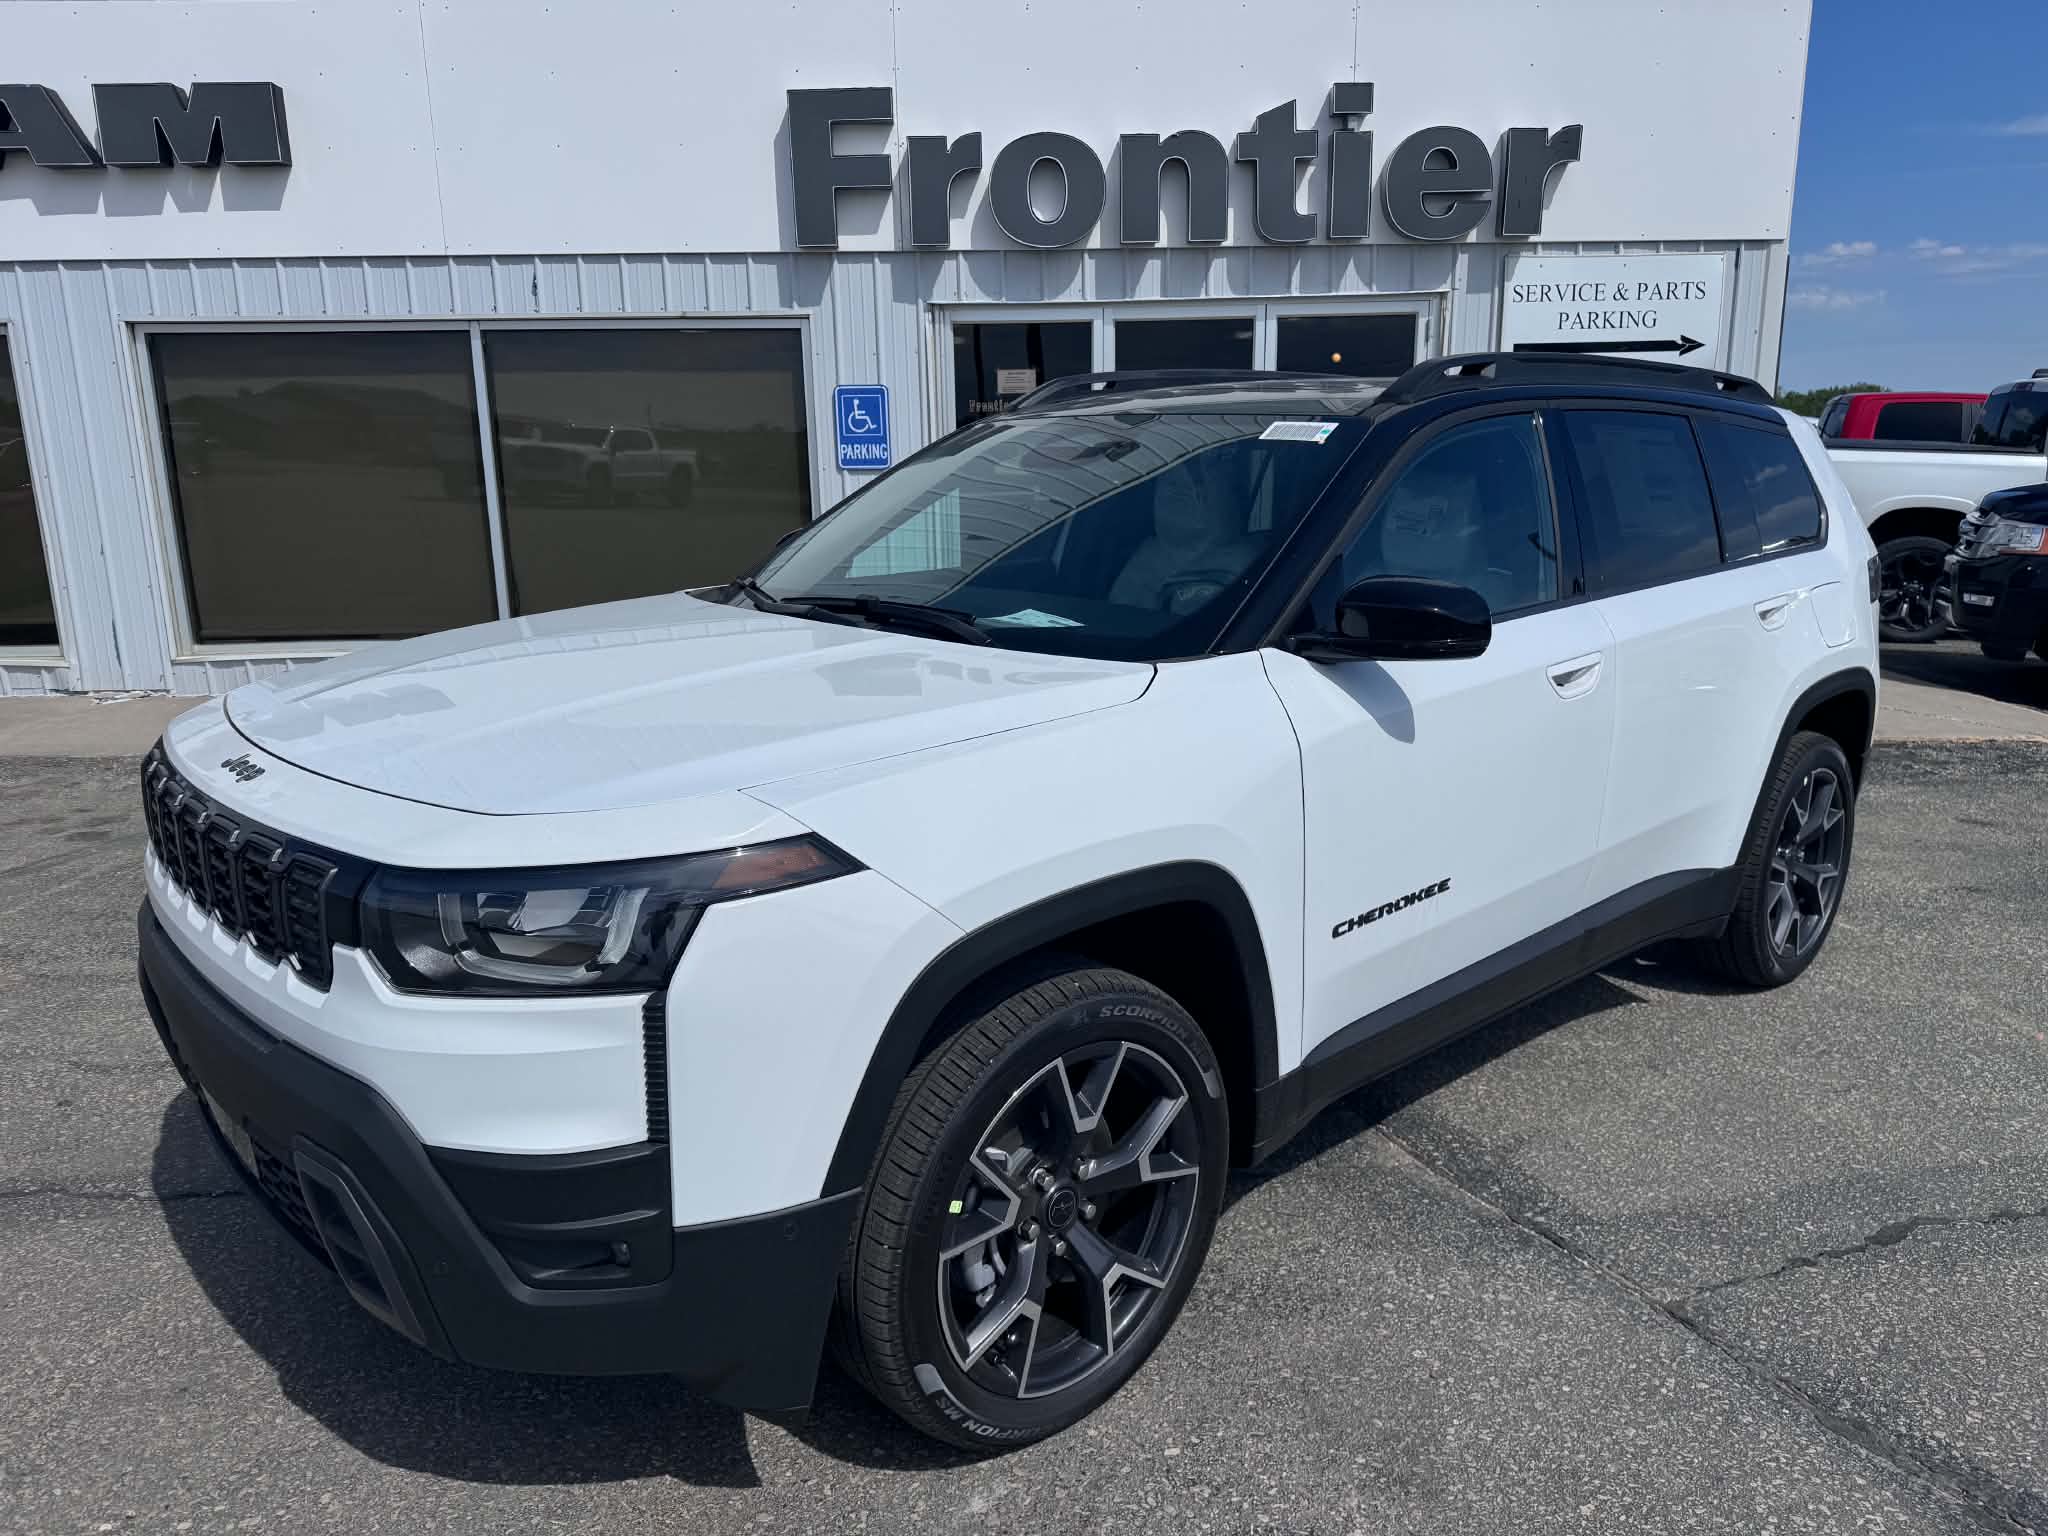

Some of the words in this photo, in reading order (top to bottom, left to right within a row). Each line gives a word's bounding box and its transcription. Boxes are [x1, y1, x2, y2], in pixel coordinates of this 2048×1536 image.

[787, 82, 1583, 248] Frontier
[1512, 283, 1606, 303] SERVICE
[1612, 282, 1629, 301] &
[1637, 281, 1707, 300] PARTS
[1557, 310, 1657, 330] PARKING
[840, 443, 888, 460] PARKING
[221, 754, 265, 783] Jeep
[1332, 877, 1451, 939] CHEROKEE
[1100, 1005, 1187, 1040] SCORPION
